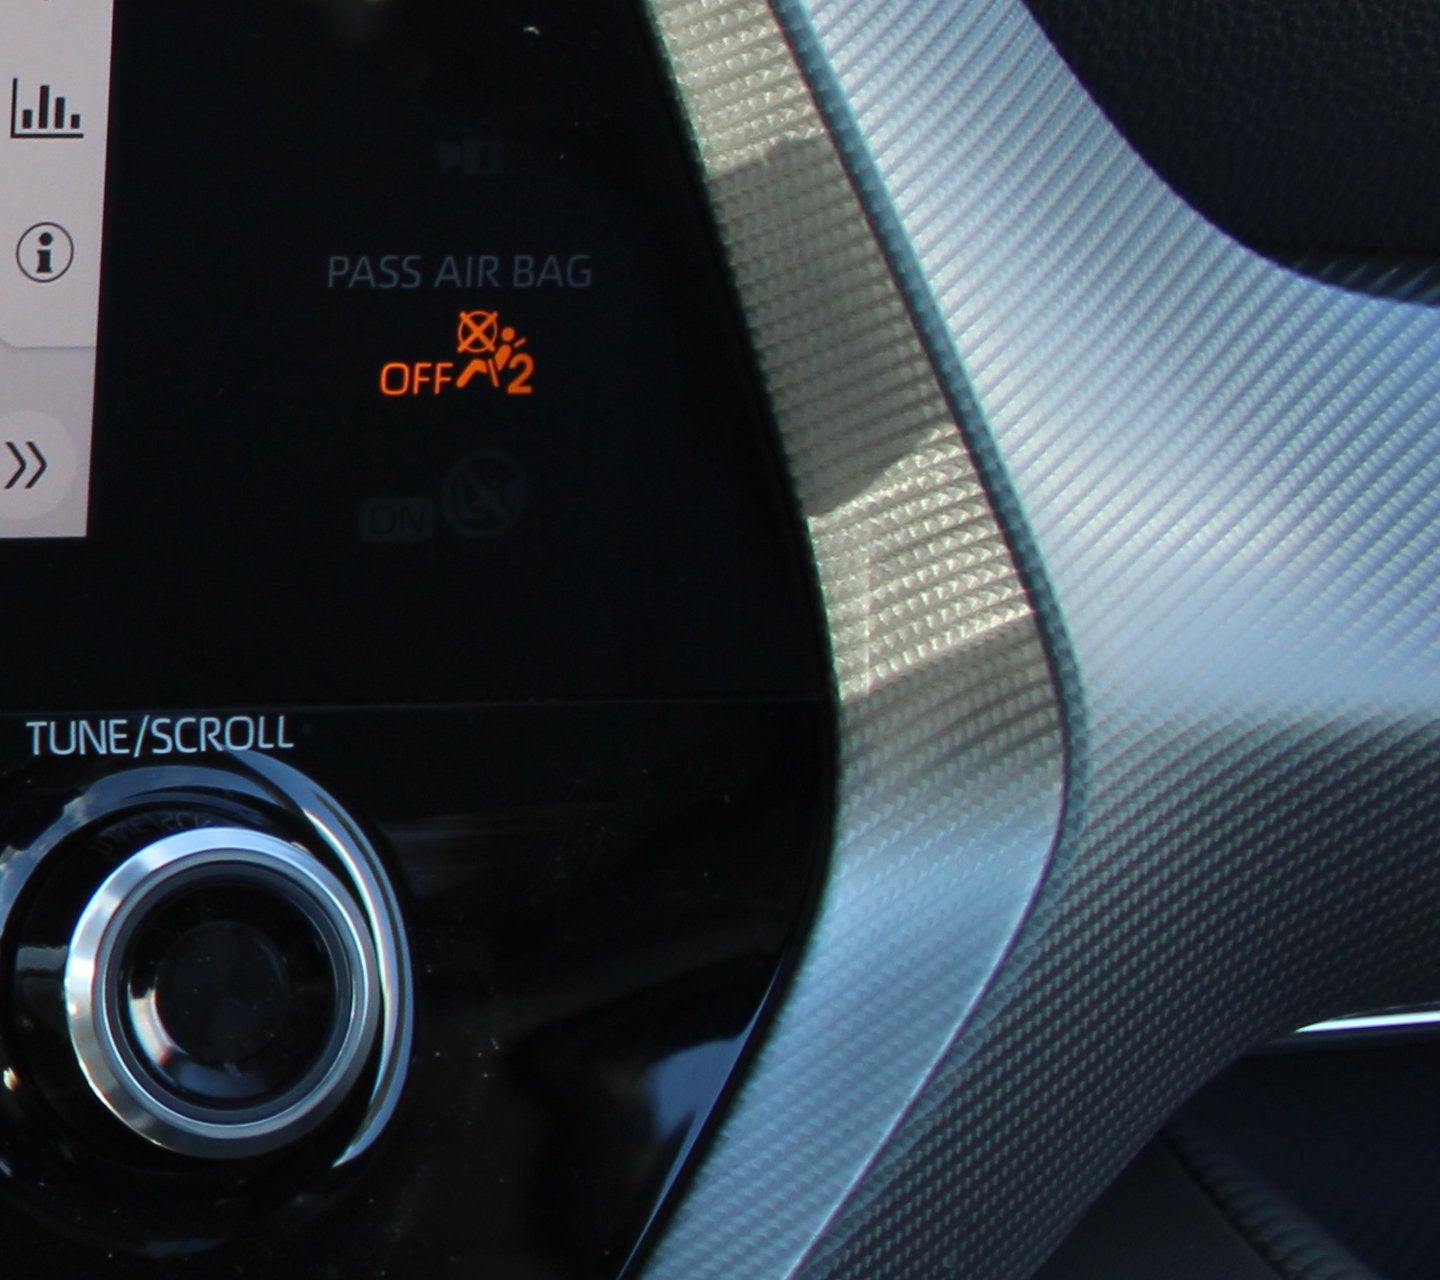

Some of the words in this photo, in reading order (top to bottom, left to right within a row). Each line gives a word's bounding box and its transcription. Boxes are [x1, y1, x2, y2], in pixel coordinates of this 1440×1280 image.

[328, 255, 422, 288] PASS
[434, 255, 501, 288] AIR
[513, 255, 592, 288] BAG
[380, 363, 453, 396] OFF
[27, 715, 294, 756] TUNE/SCROLL
